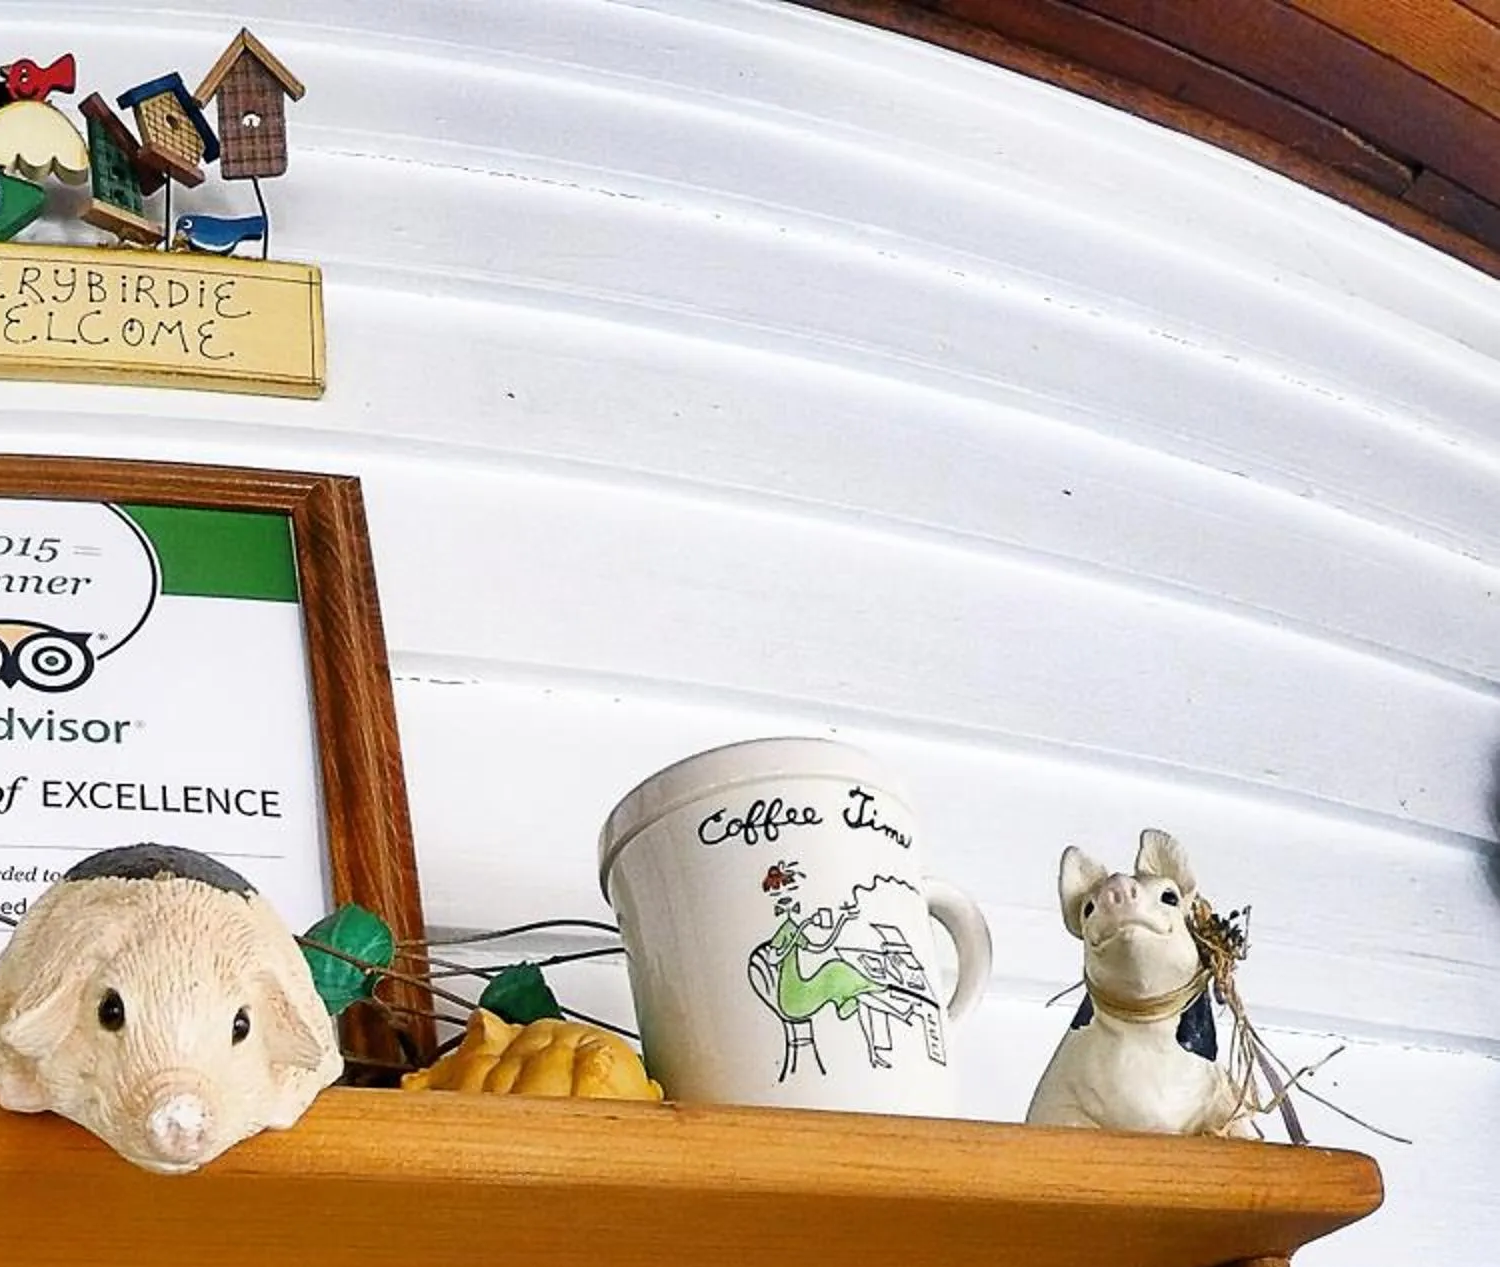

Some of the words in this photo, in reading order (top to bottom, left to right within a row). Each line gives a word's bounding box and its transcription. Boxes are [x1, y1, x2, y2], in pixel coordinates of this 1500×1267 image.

[42, 780, 282, 818] EXCELLENCE
[697, 797, 823, 846] Coffee
[842, 786, 912, 849] Time
[43, 869, 61, 882] to
